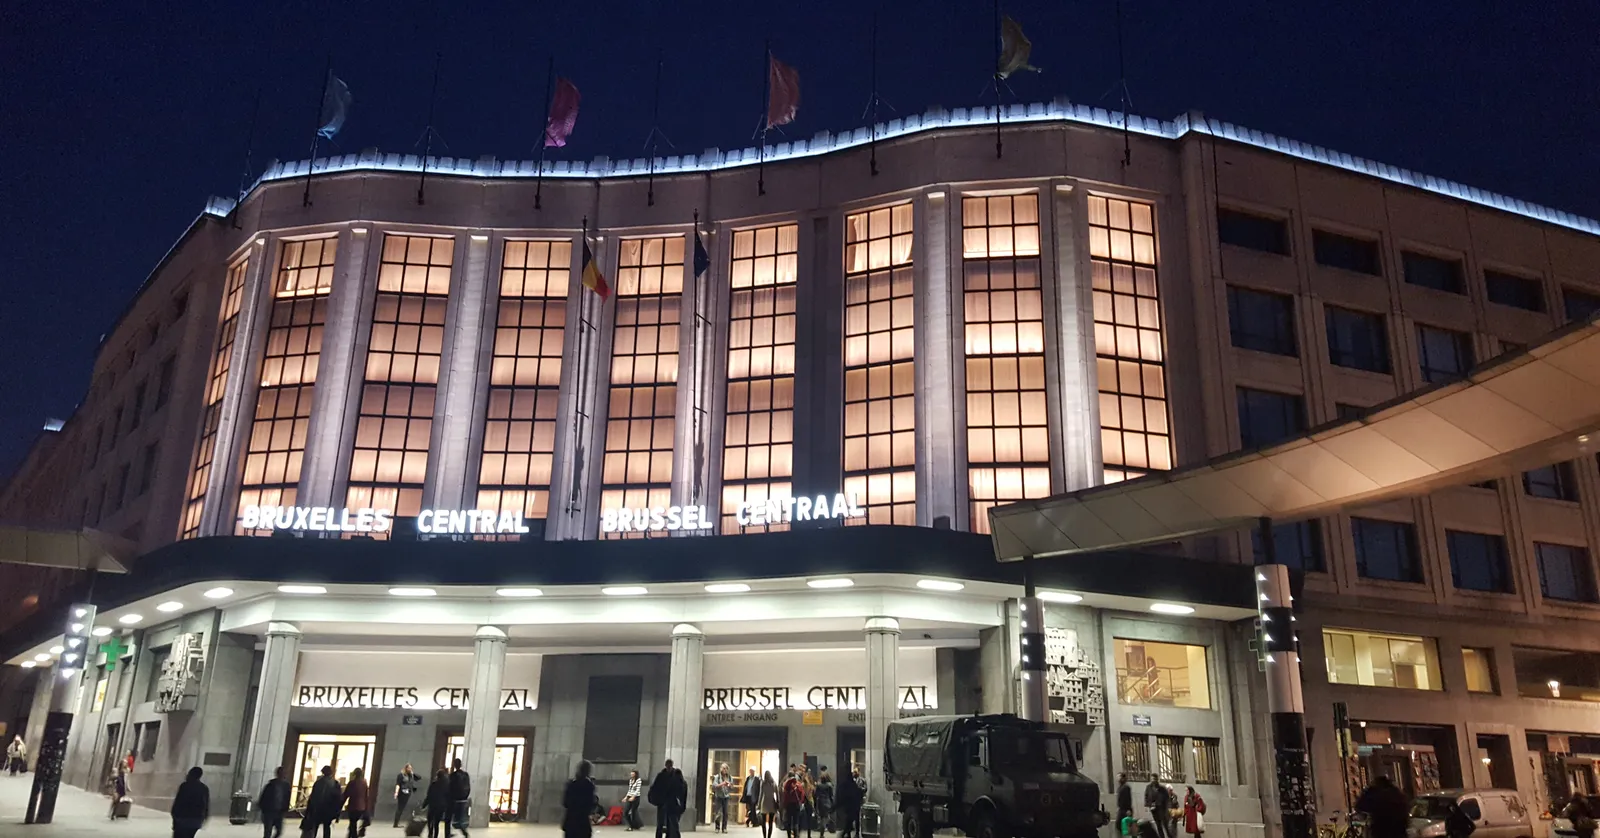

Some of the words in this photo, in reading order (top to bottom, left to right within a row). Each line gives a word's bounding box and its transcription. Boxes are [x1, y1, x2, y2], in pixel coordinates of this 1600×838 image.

[242, 505, 390, 532] BRUXELLES
[418, 509, 529, 533] CENTRAL
[602, 505, 713, 532] BRUSSEL
[737, 492, 865, 526] CENTRAAL
[298, 685, 418, 708] BRUXELLES
[433, 687, 532, 709] CENAL
[703, 686, 794, 709] BRUSSEL
[807, 685, 933, 709] CENTAL
[744, 712, 778, 721] INGANG
